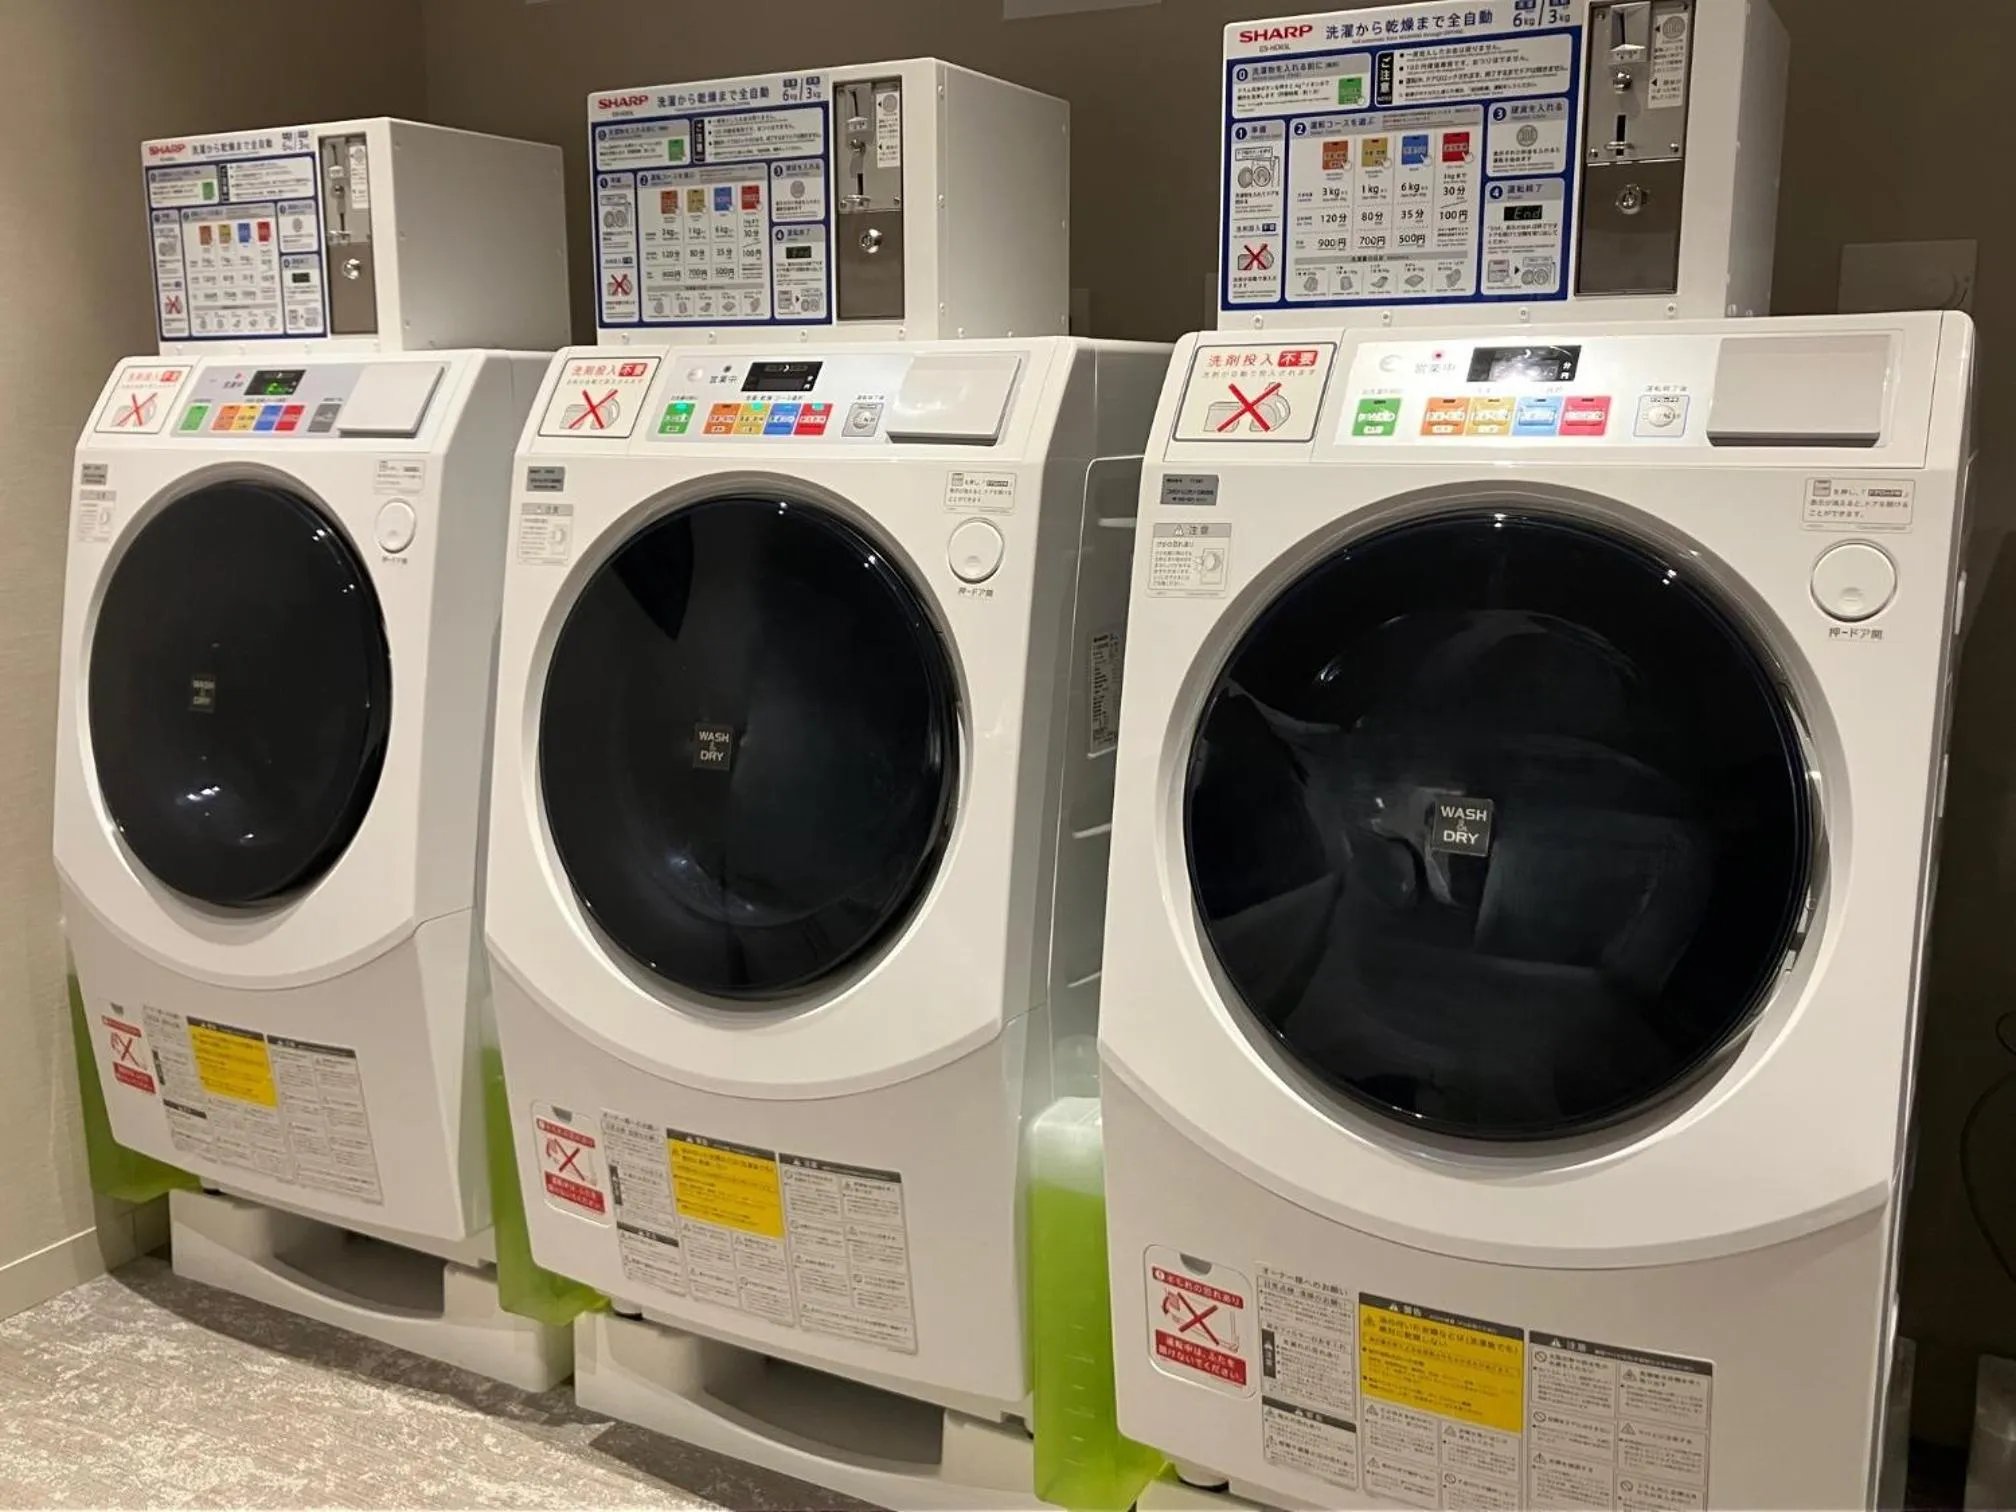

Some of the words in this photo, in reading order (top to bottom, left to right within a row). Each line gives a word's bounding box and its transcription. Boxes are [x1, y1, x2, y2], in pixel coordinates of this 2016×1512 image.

[1326, 9, 1494, 40] 洗濯から乾燥まで全自動
[1513, 12, 1536, 27] 6kg
[1548, 9, 1571, 24] 3kg
[1239, 24, 1314, 43] SHARP
[598, 95, 649, 110] SHARP
[656, 86, 770, 108] 洗濯から乾燥まで全自動
[148, 143, 186, 156] SHARP
[1320, 213, 1347, 224] 120分
[1361, 211, 1384, 222] 80分
[1401, 208, 1424, 219] 35分
[1440, 209, 1468, 221] 100円
[1359, 236, 1386, 246] 700円
[1399, 234, 1426, 244] 500円
[1208, 352, 1274, 368] 洗剤投入
[1280, 351, 1315, 367] 不要
[1414, 362, 1457, 375] 営業中
[699, 731, 730, 743] WASH
[700, 750, 724, 761] DRY
[1441, 806, 1487, 821] WASH
[1443, 830, 1480, 845] DRY
